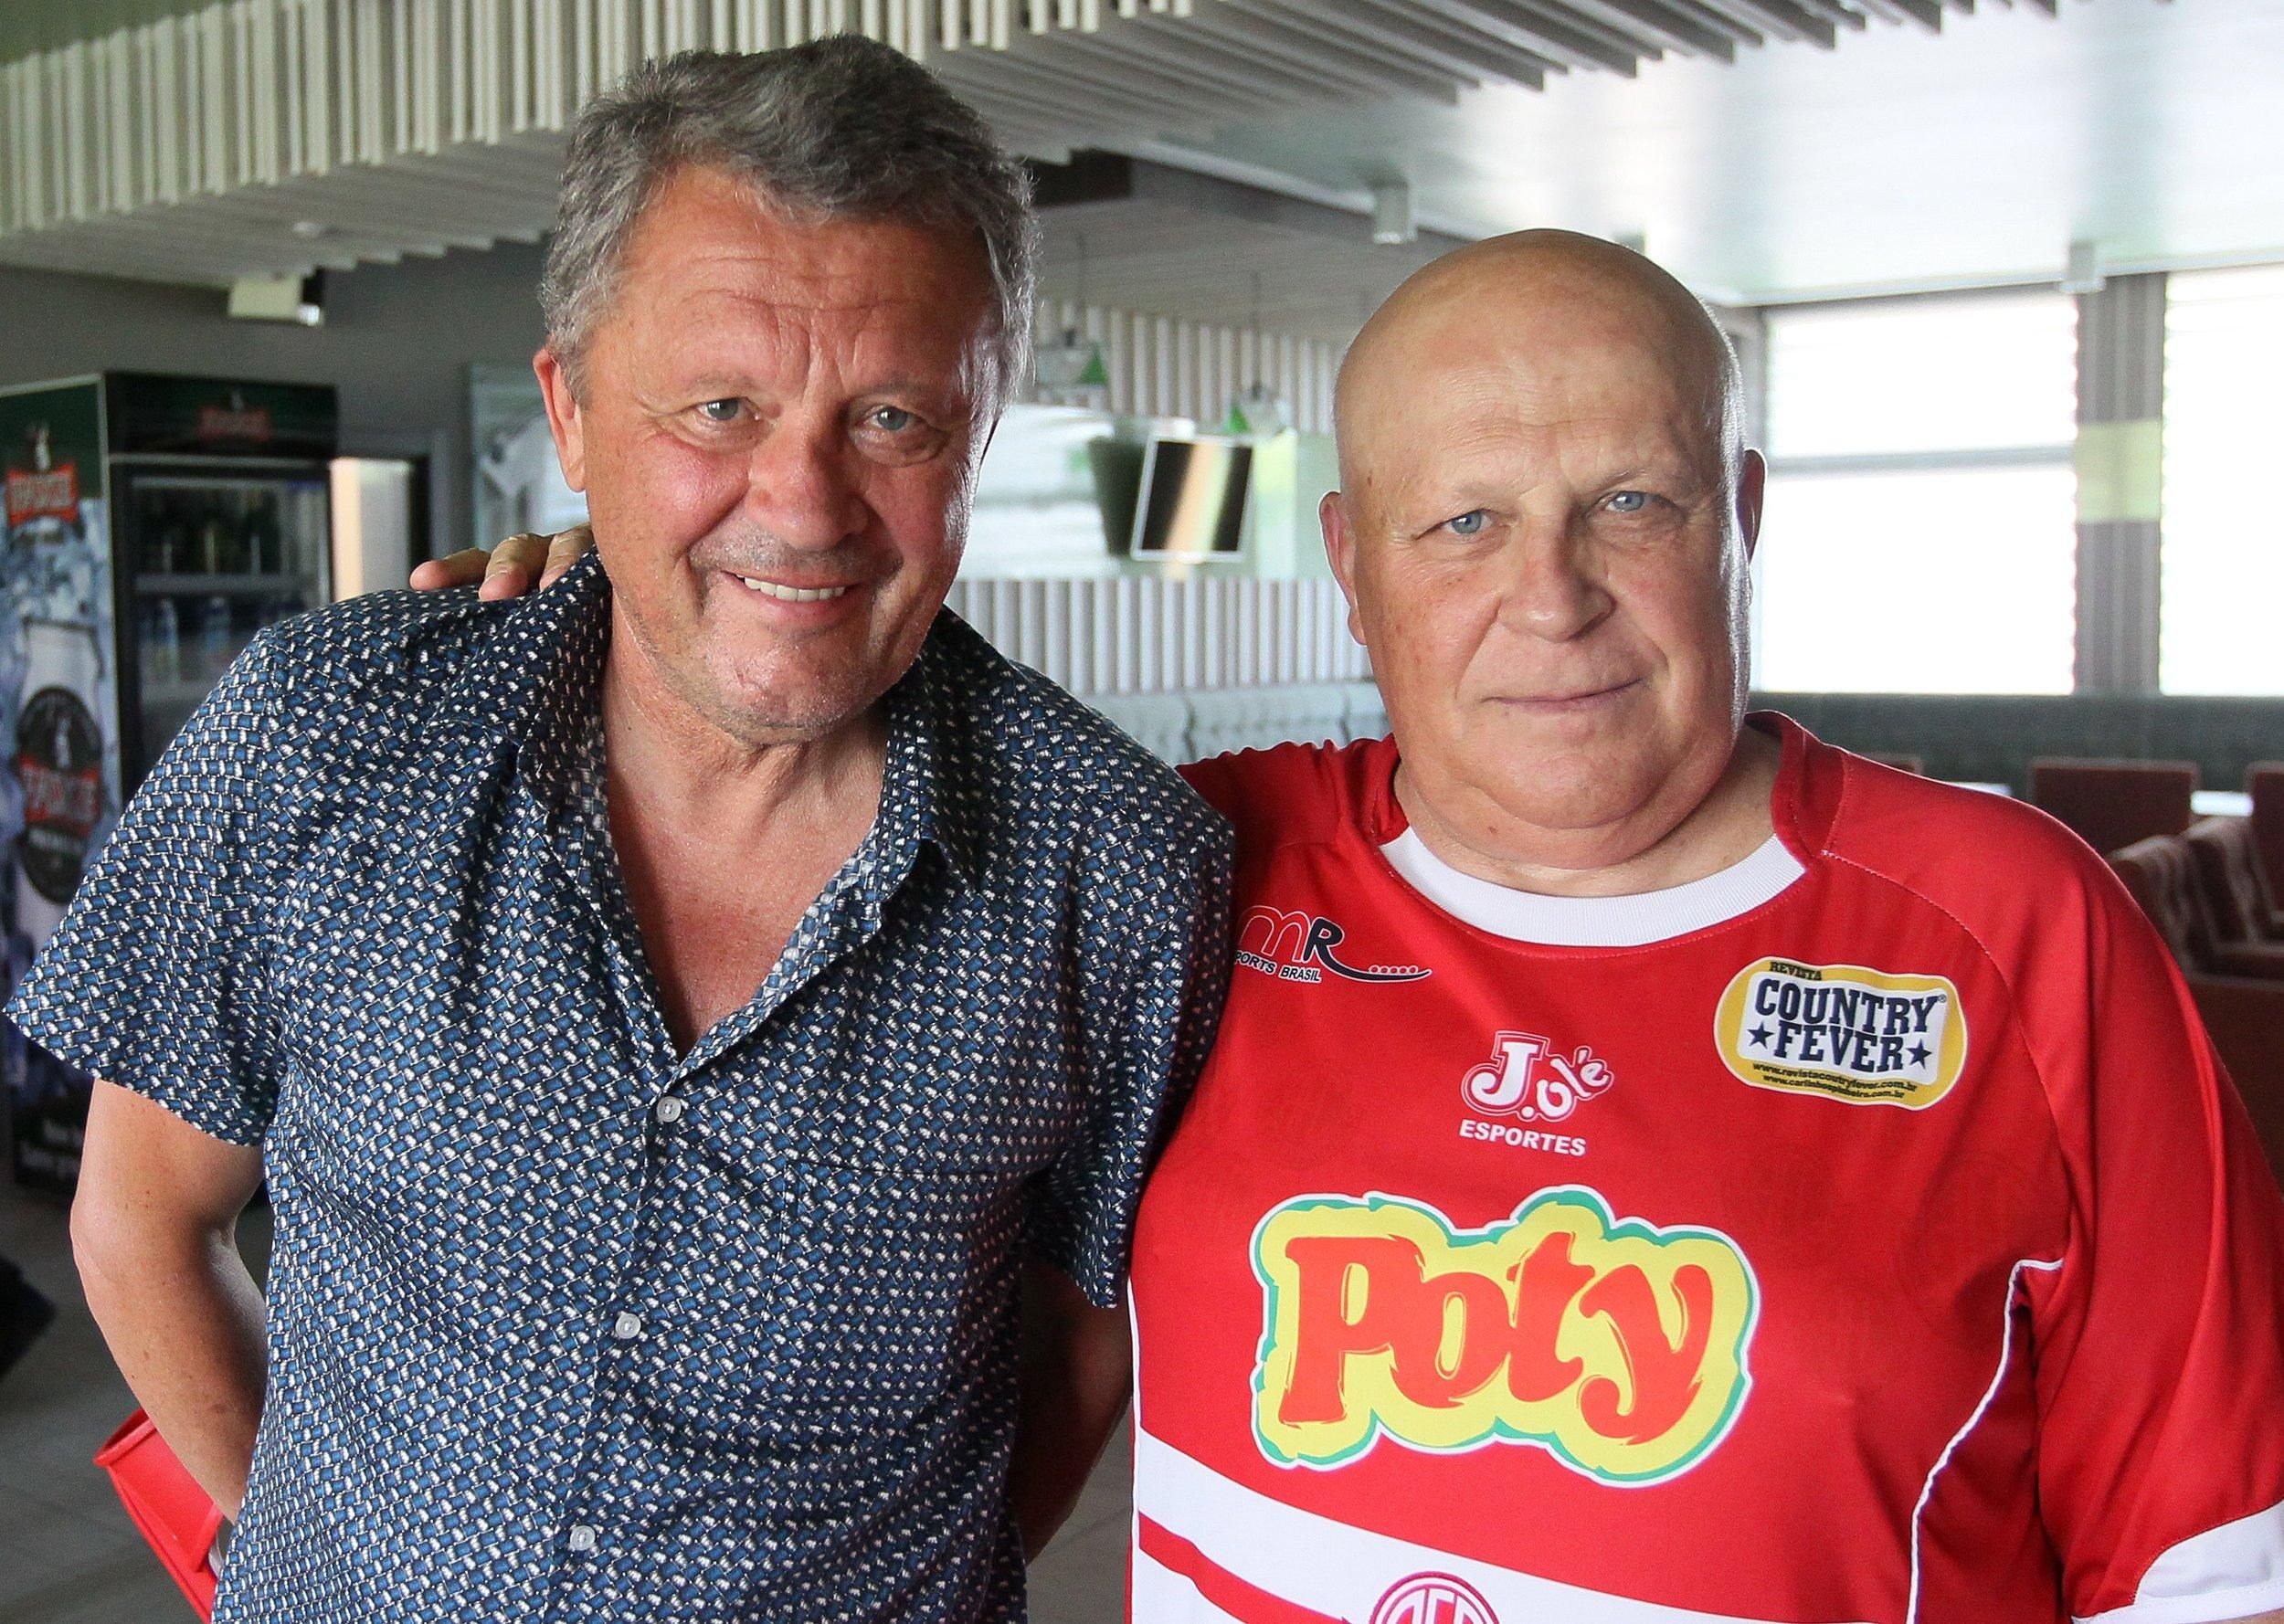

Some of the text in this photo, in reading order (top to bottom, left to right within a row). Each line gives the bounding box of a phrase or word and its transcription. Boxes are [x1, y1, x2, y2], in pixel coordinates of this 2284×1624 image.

[1234, 951, 1322, 983] PORTS BRASIL
[1769, 961, 1822, 981] REVISTA
[1773, 1019, 1903, 1072] FEVER
[1459, 1119, 1586, 1156] ESPORTES
